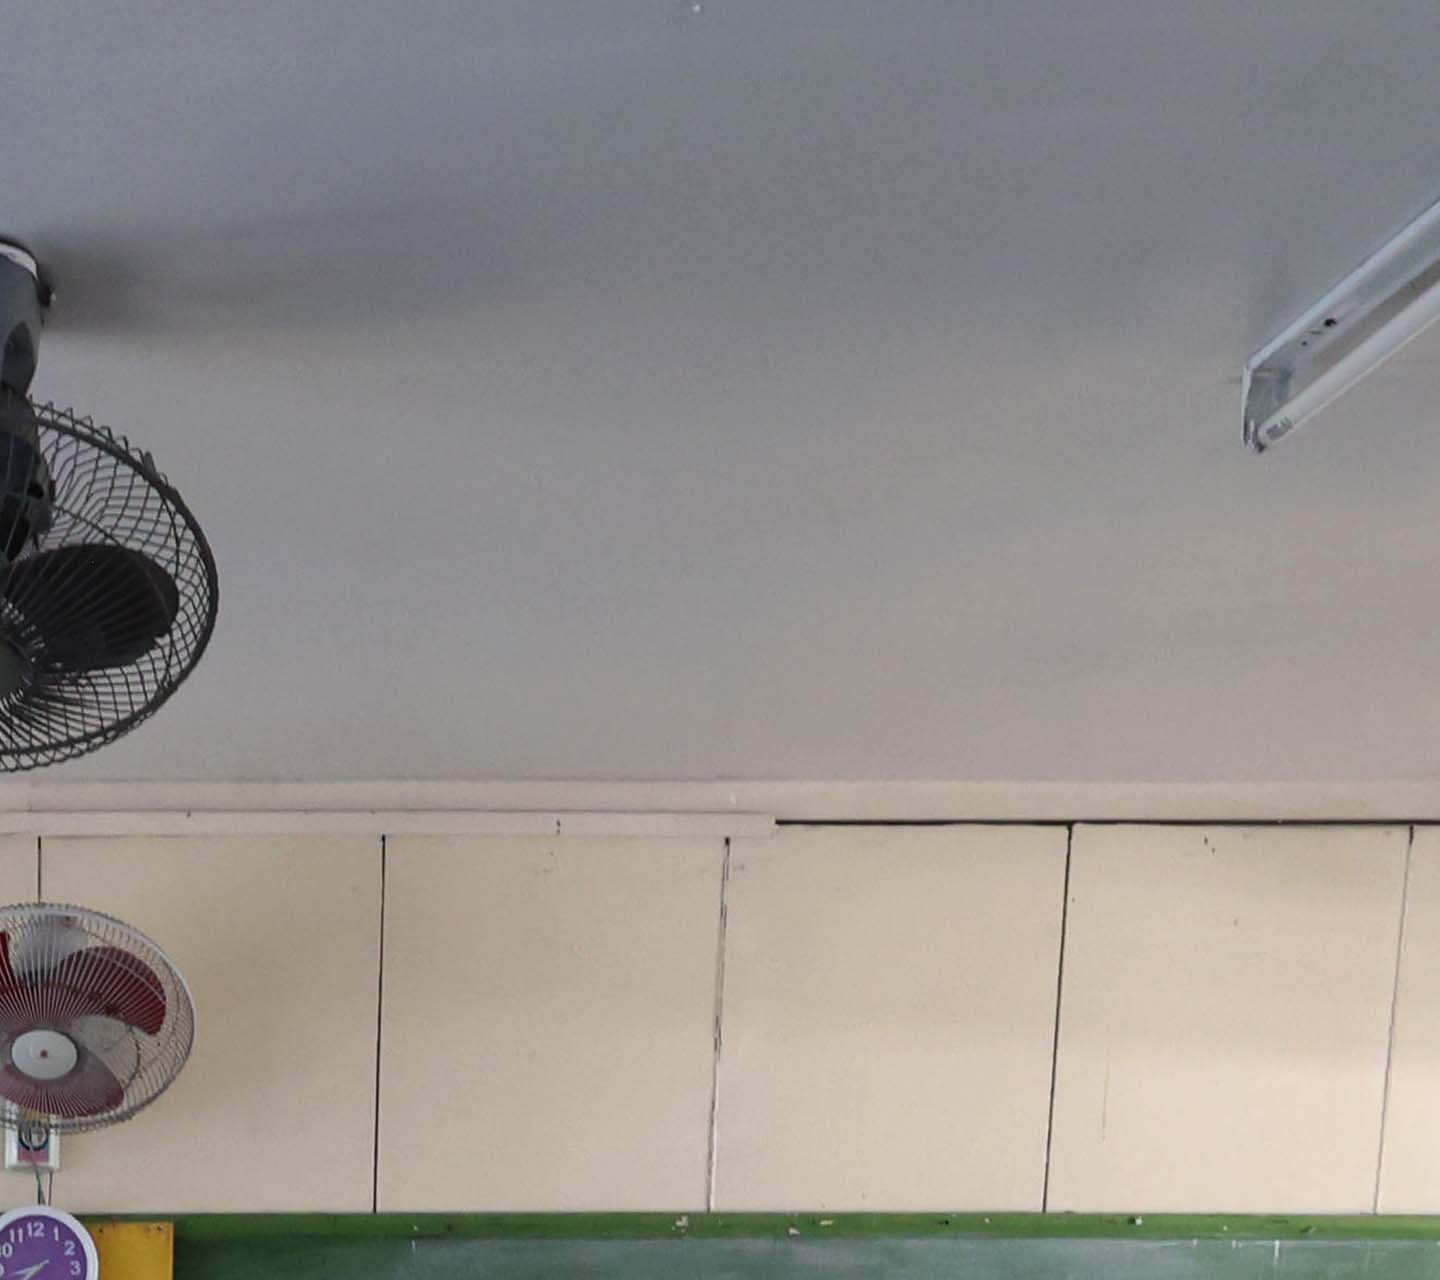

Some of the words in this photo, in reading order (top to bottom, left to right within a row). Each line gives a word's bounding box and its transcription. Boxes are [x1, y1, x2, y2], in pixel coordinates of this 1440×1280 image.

[9, 1228, 24, 1243] 11
[26, 1222, 45, 1238] 12
[53, 1227, 60, 1241] 1
[64, 1241, 77, 1256] 2
[70, 1260, 81, 1275] 3
